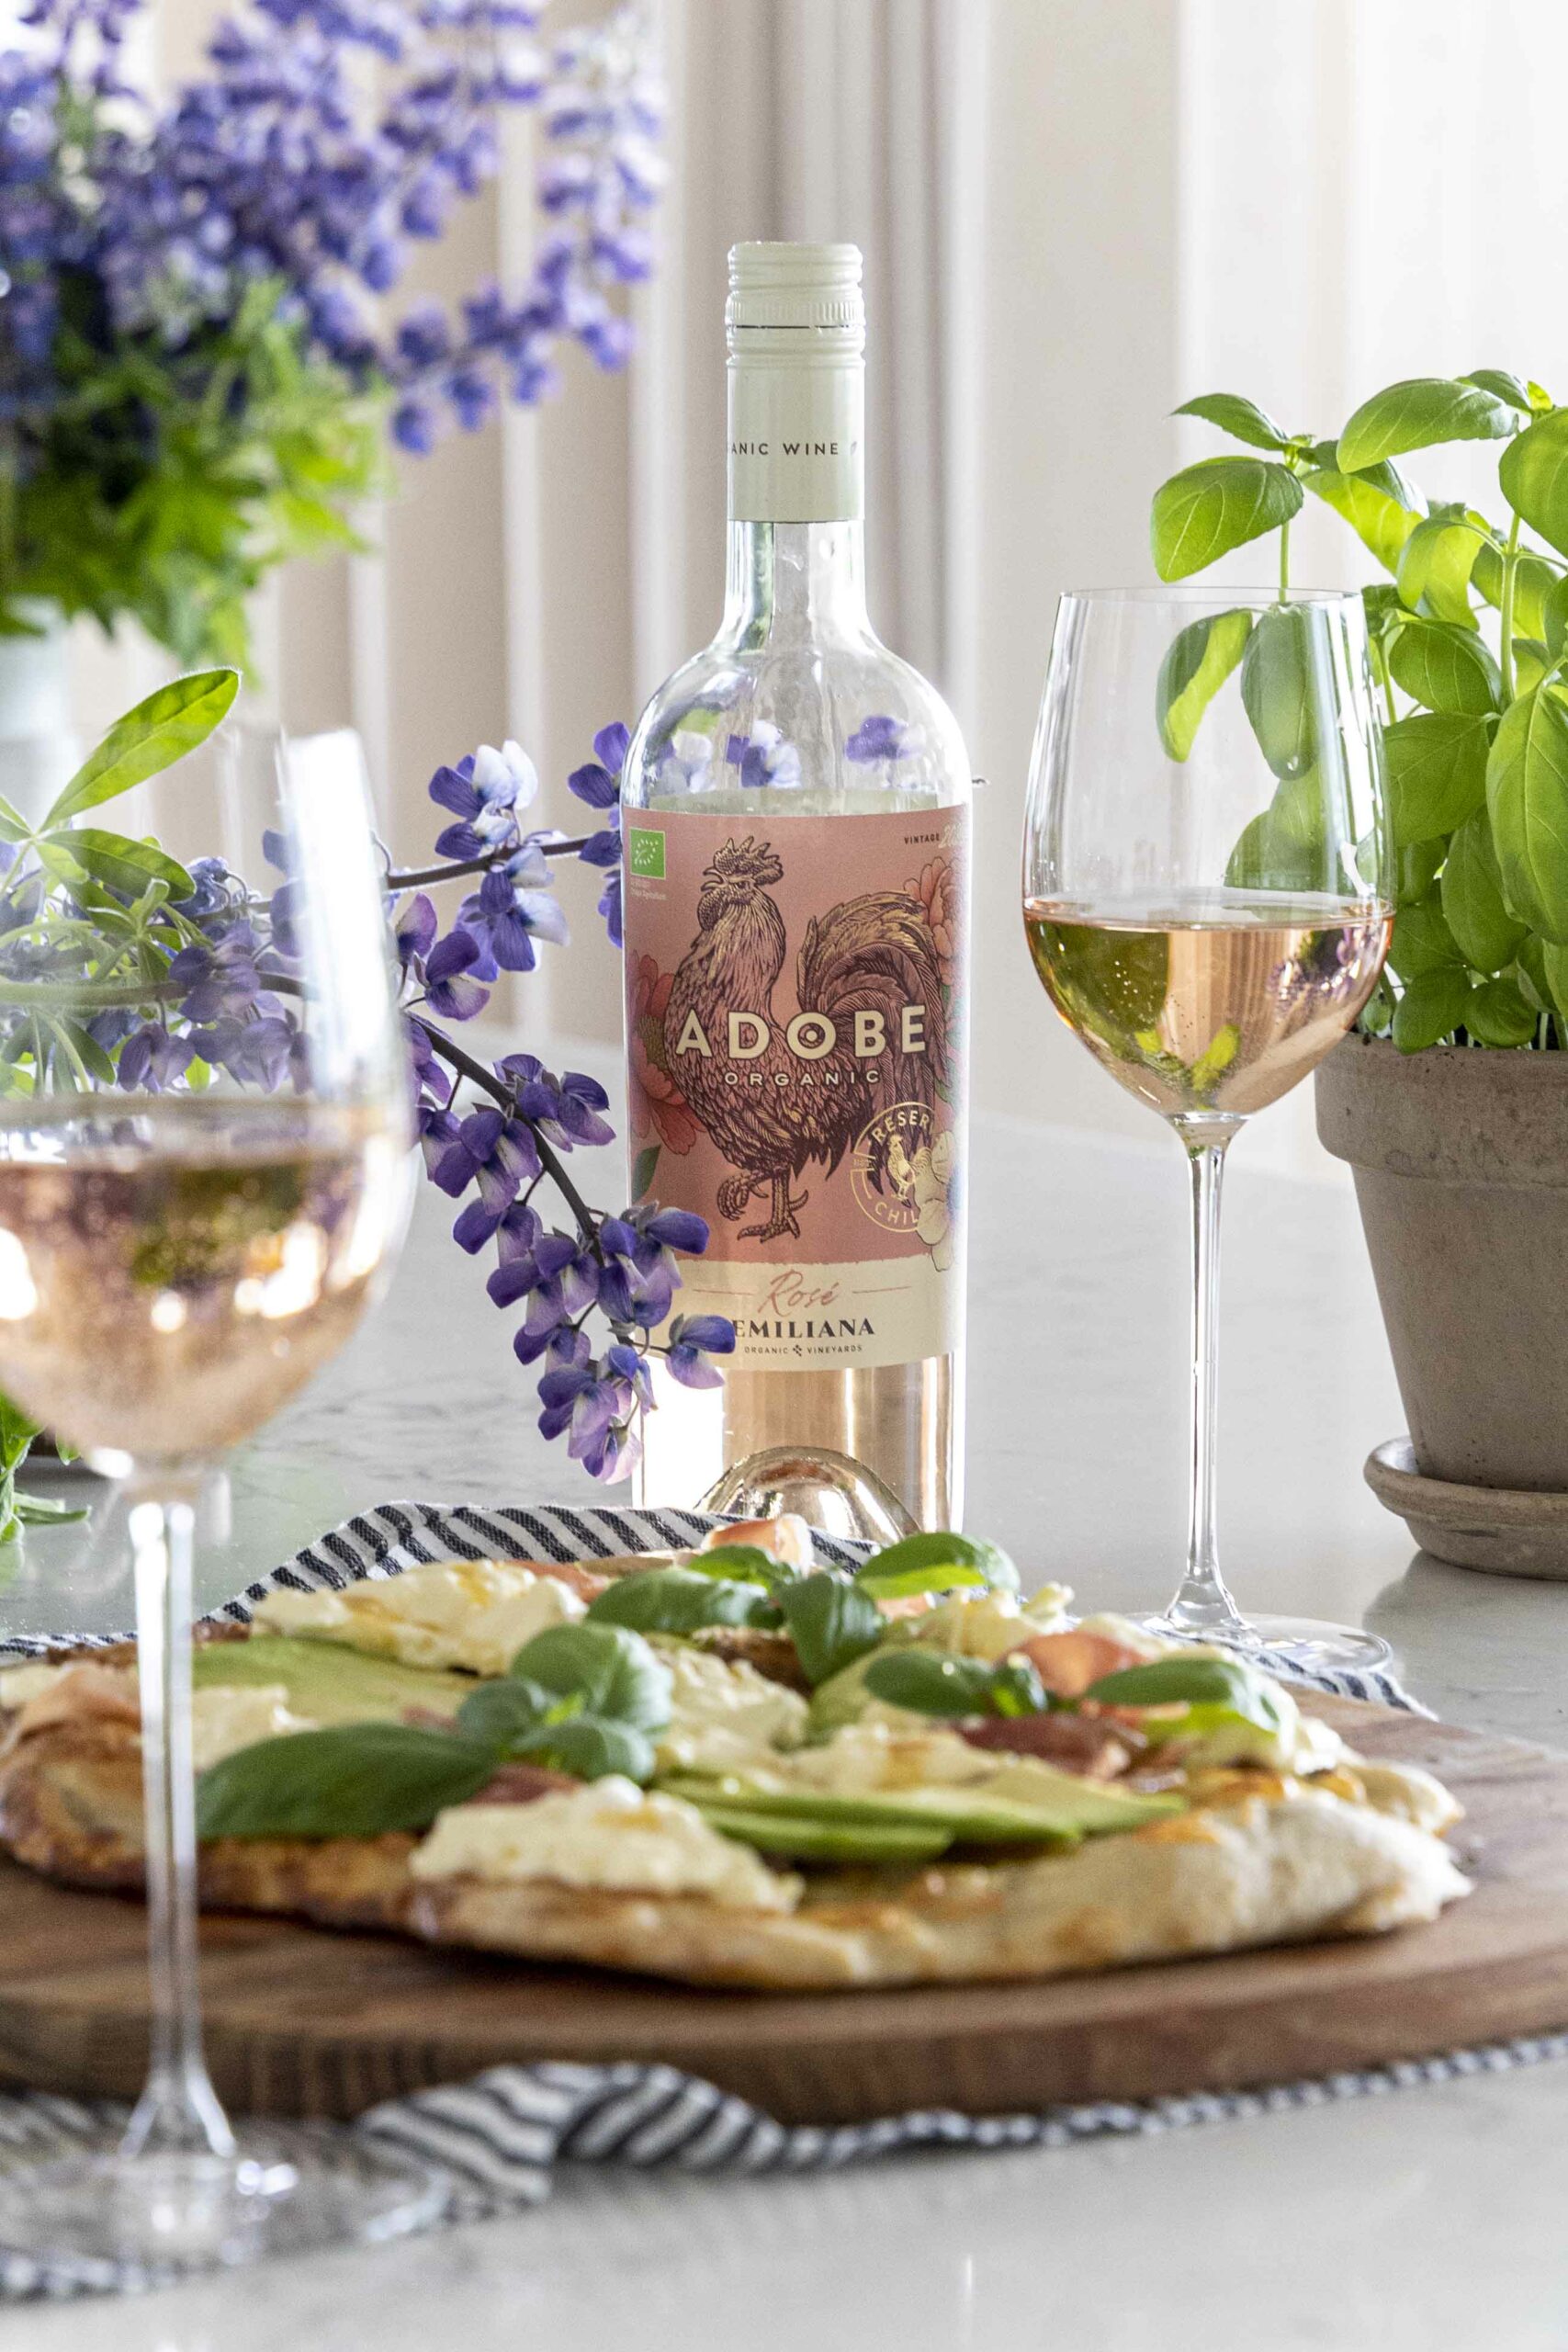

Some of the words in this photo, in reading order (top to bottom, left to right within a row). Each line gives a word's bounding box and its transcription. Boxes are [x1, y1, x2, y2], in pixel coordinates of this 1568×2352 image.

[782, 442, 839, 456] WINE
[904, 832, 940, 844] VINTAGE
[675, 1005, 926, 1059] ADOBE
[724, 1069, 880, 1086] ORGANIC
[871, 1110, 934, 1143] RESER
[874, 1202, 919, 1225] CHIL
[757, 1268, 840, 1317] Rosé
[731, 1317, 875, 1339] EMILIANA
[744, 1344, 789, 1355] ORGANIC
[807, 1344, 863, 1355] VINEYARDS
